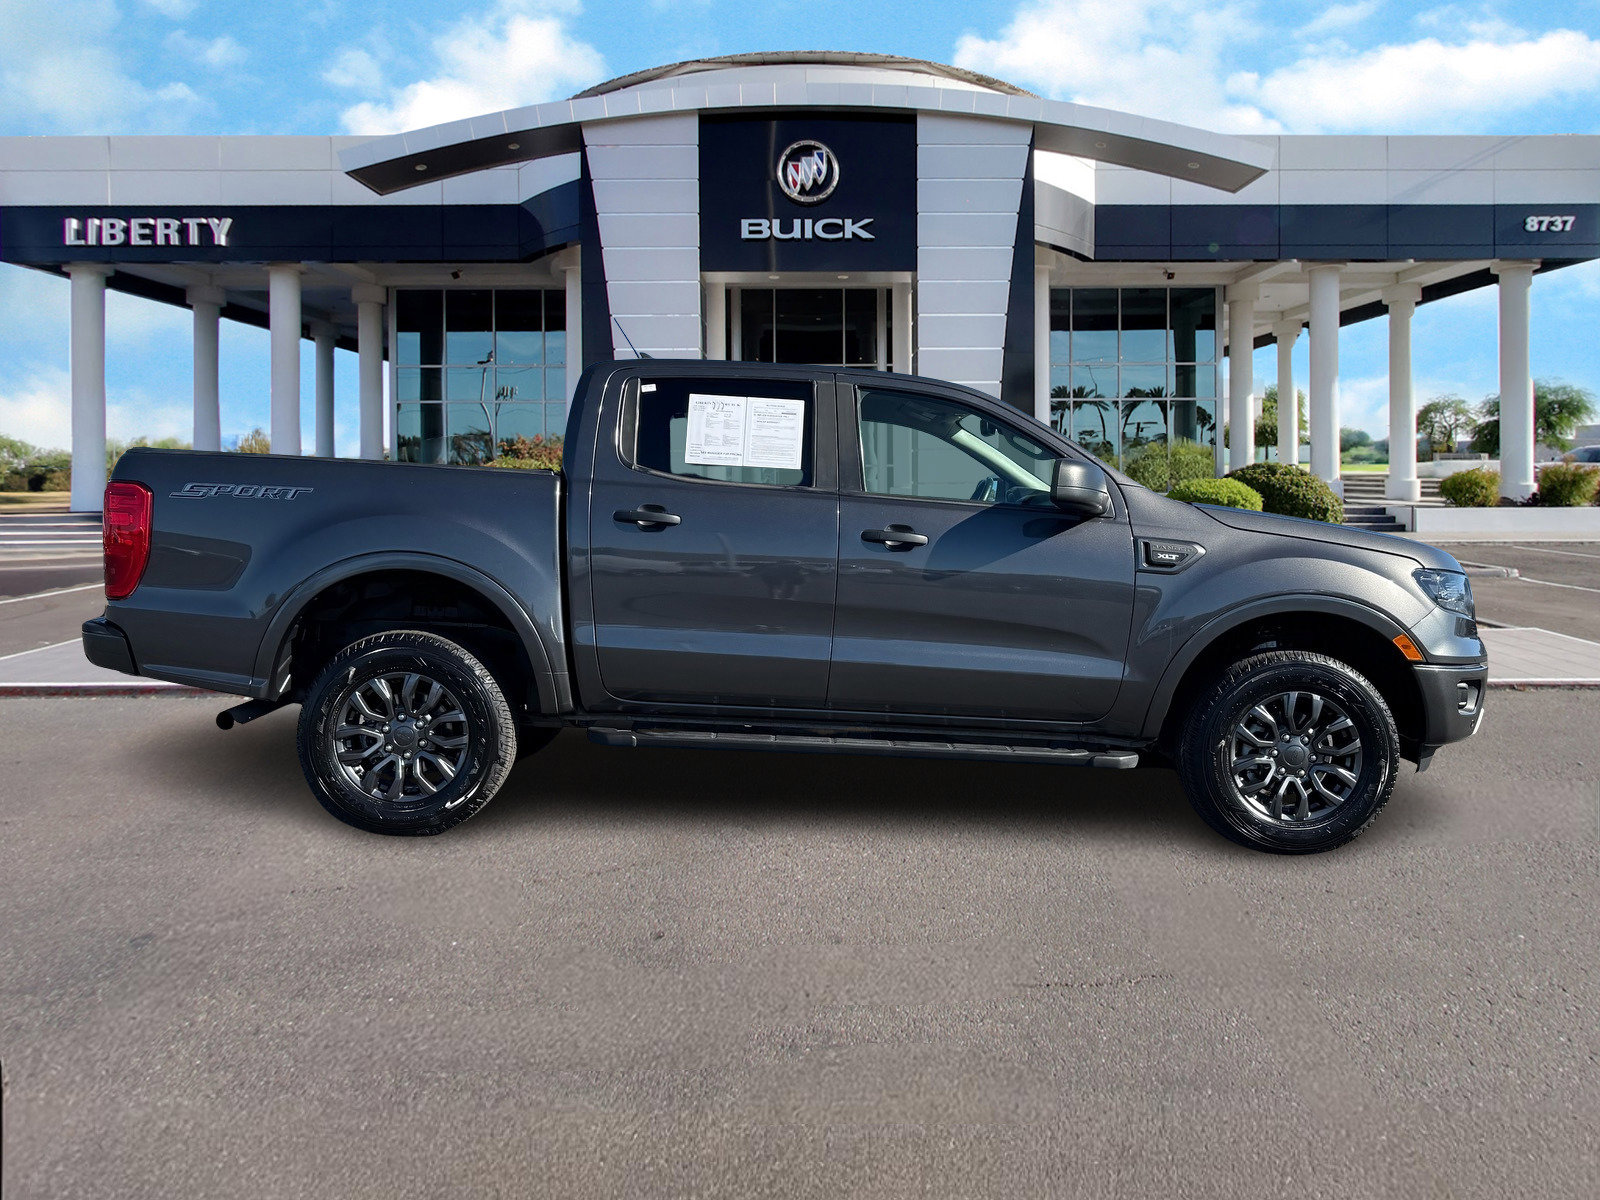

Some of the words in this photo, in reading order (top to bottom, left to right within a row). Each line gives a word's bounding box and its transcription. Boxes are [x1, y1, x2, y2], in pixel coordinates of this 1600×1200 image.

[63, 217, 234, 247] LIBERTY
[740, 218, 876, 240] BUICK
[1524, 215, 1577, 232] 8737
[168, 482, 314, 500] SPORT
